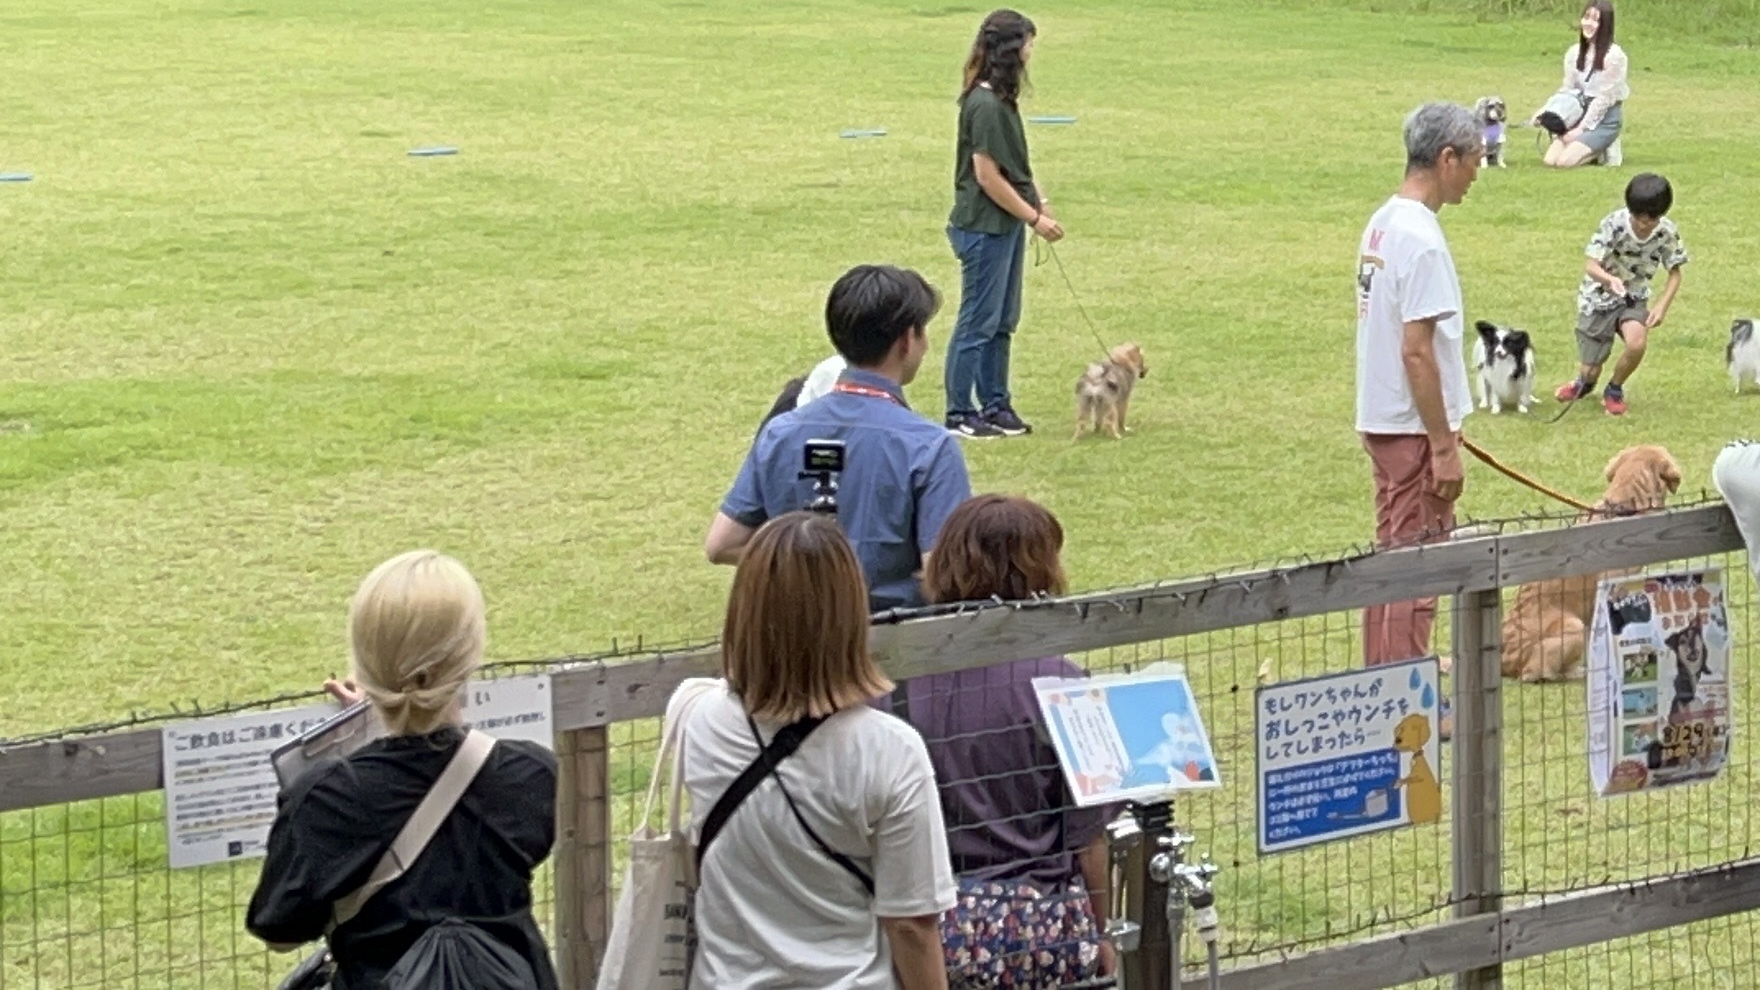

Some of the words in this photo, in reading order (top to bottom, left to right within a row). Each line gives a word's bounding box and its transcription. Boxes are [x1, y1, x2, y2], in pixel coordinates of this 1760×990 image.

[1265, 678, 1383, 715] もしワンちゃんが
[1265, 697, 1410, 741] おしっこやウンチを
